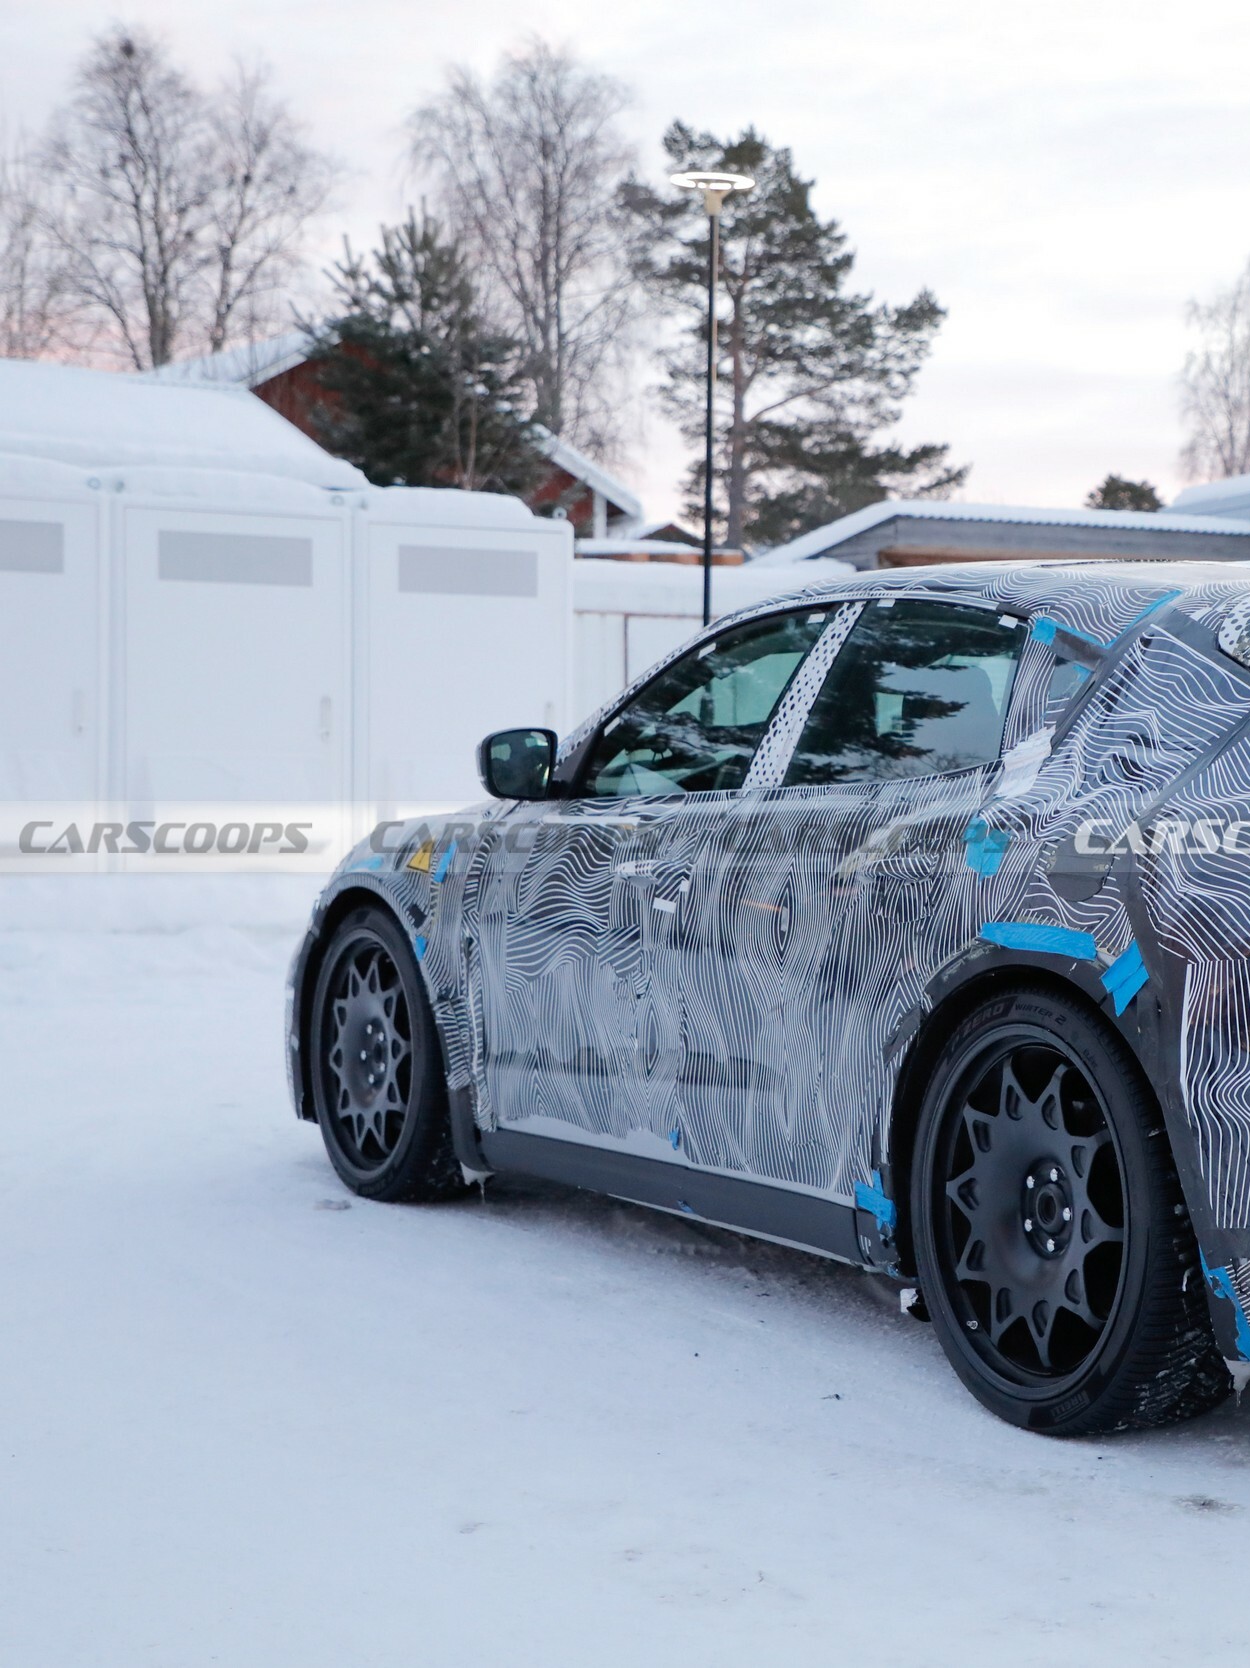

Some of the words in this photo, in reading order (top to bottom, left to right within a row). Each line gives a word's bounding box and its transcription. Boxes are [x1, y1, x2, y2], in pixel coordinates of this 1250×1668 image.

[961, 1003, 1005, 1038] ZERO
[1015, 1003, 1053, 1018] WINTER
[1054, 1014, 1067, 1026] 2
[1050, 1389, 1090, 1421] PIRELLI
